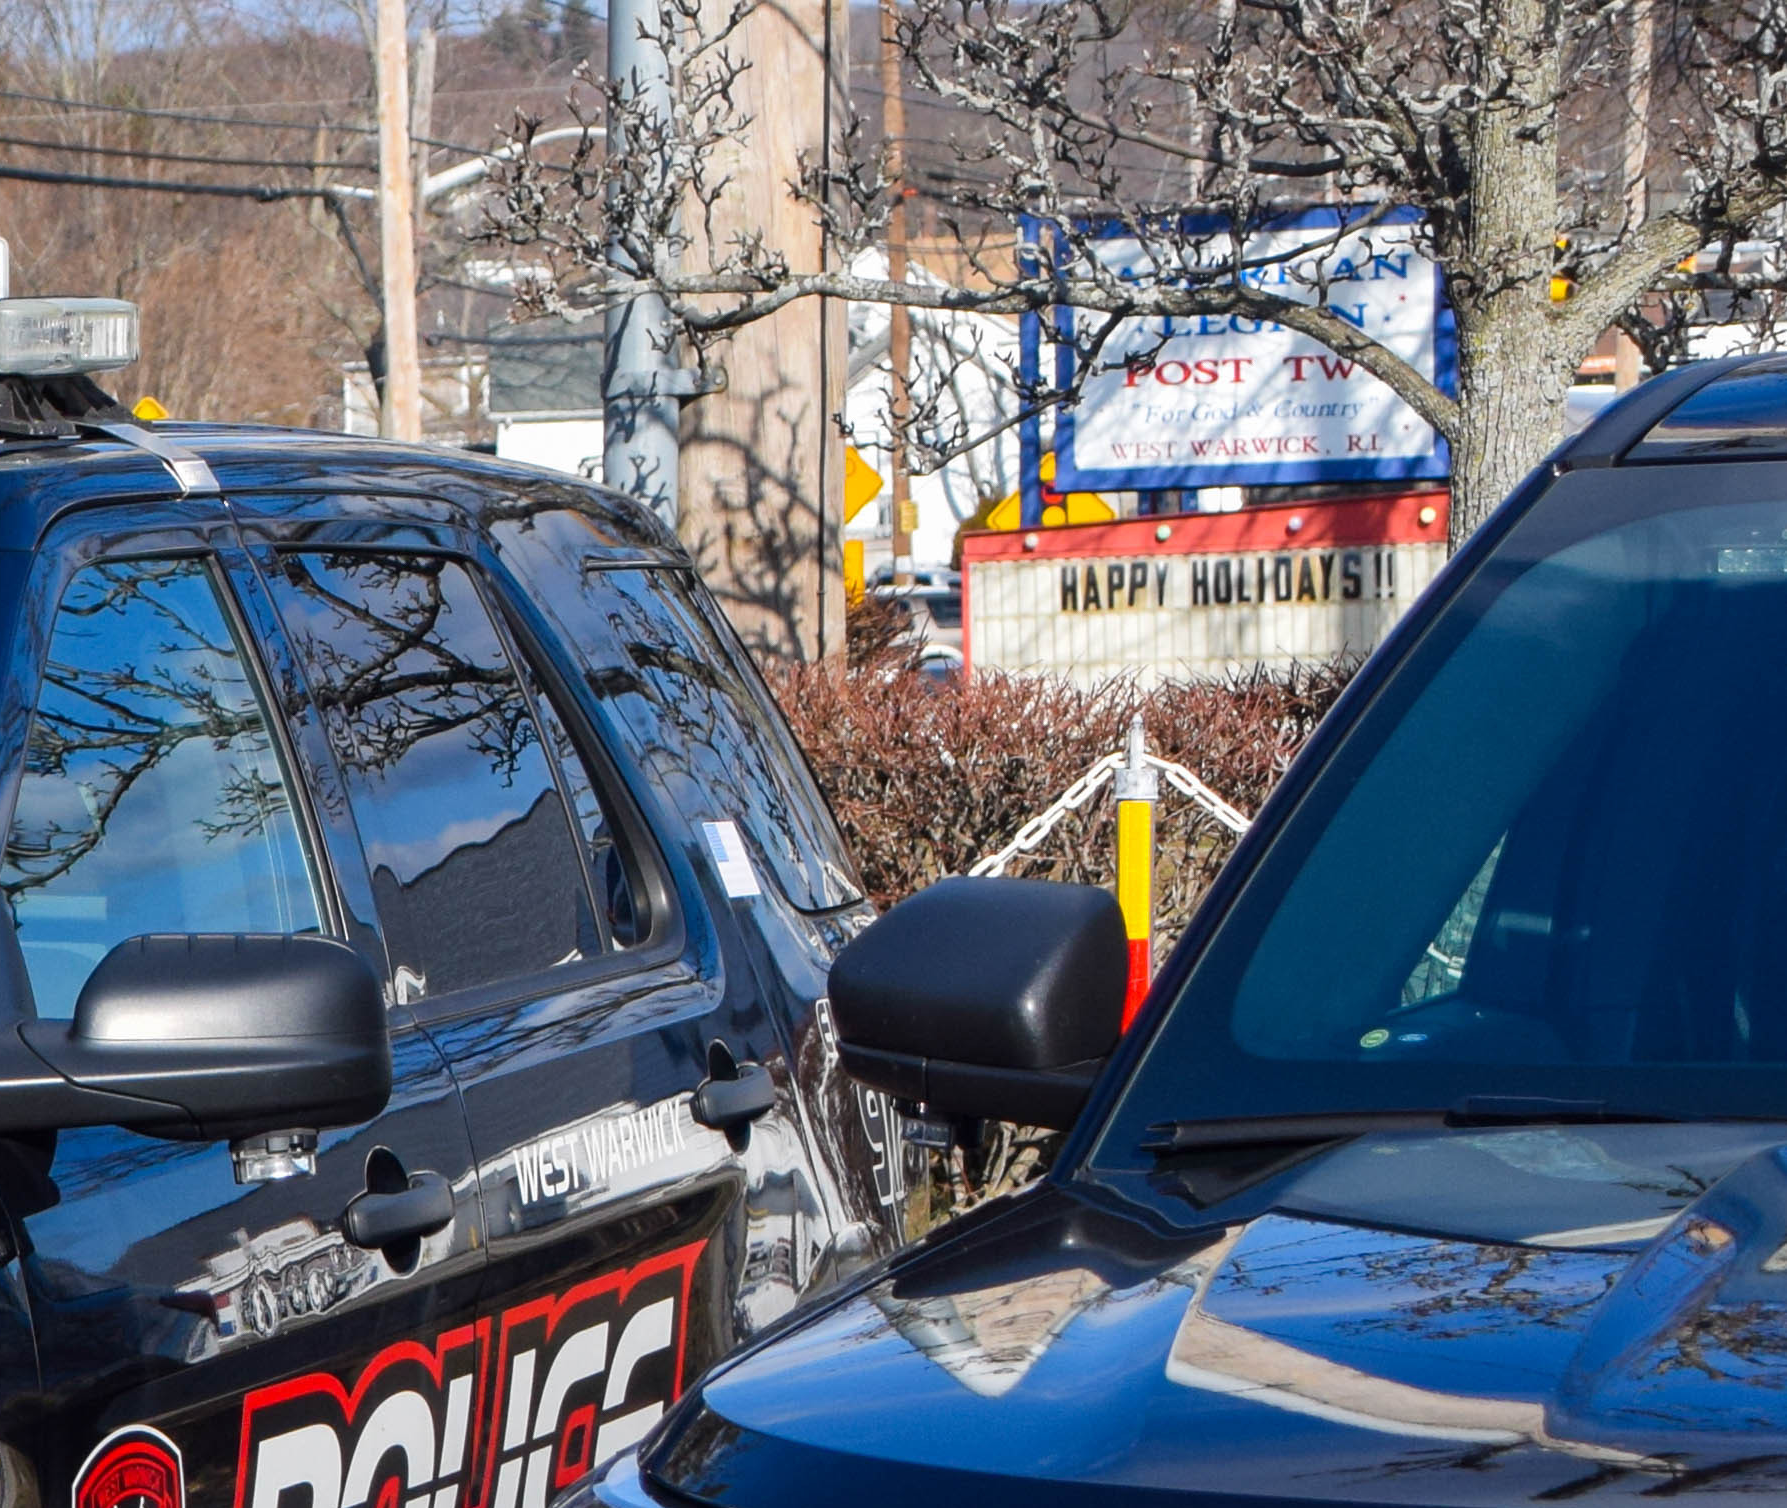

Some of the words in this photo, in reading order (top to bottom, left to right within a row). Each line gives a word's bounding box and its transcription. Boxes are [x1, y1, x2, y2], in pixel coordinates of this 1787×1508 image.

[1123, 358, 1253, 388] POST
[1283, 355, 1361, 382] TW
[1190, 400, 1237, 422] God
[1111, 441, 1178, 460] WEST
[1061, 561, 1169, 612] HAPPY
[513, 1132, 579, 1206] WEST
[582, 1096, 686, 1183] WARWICK
